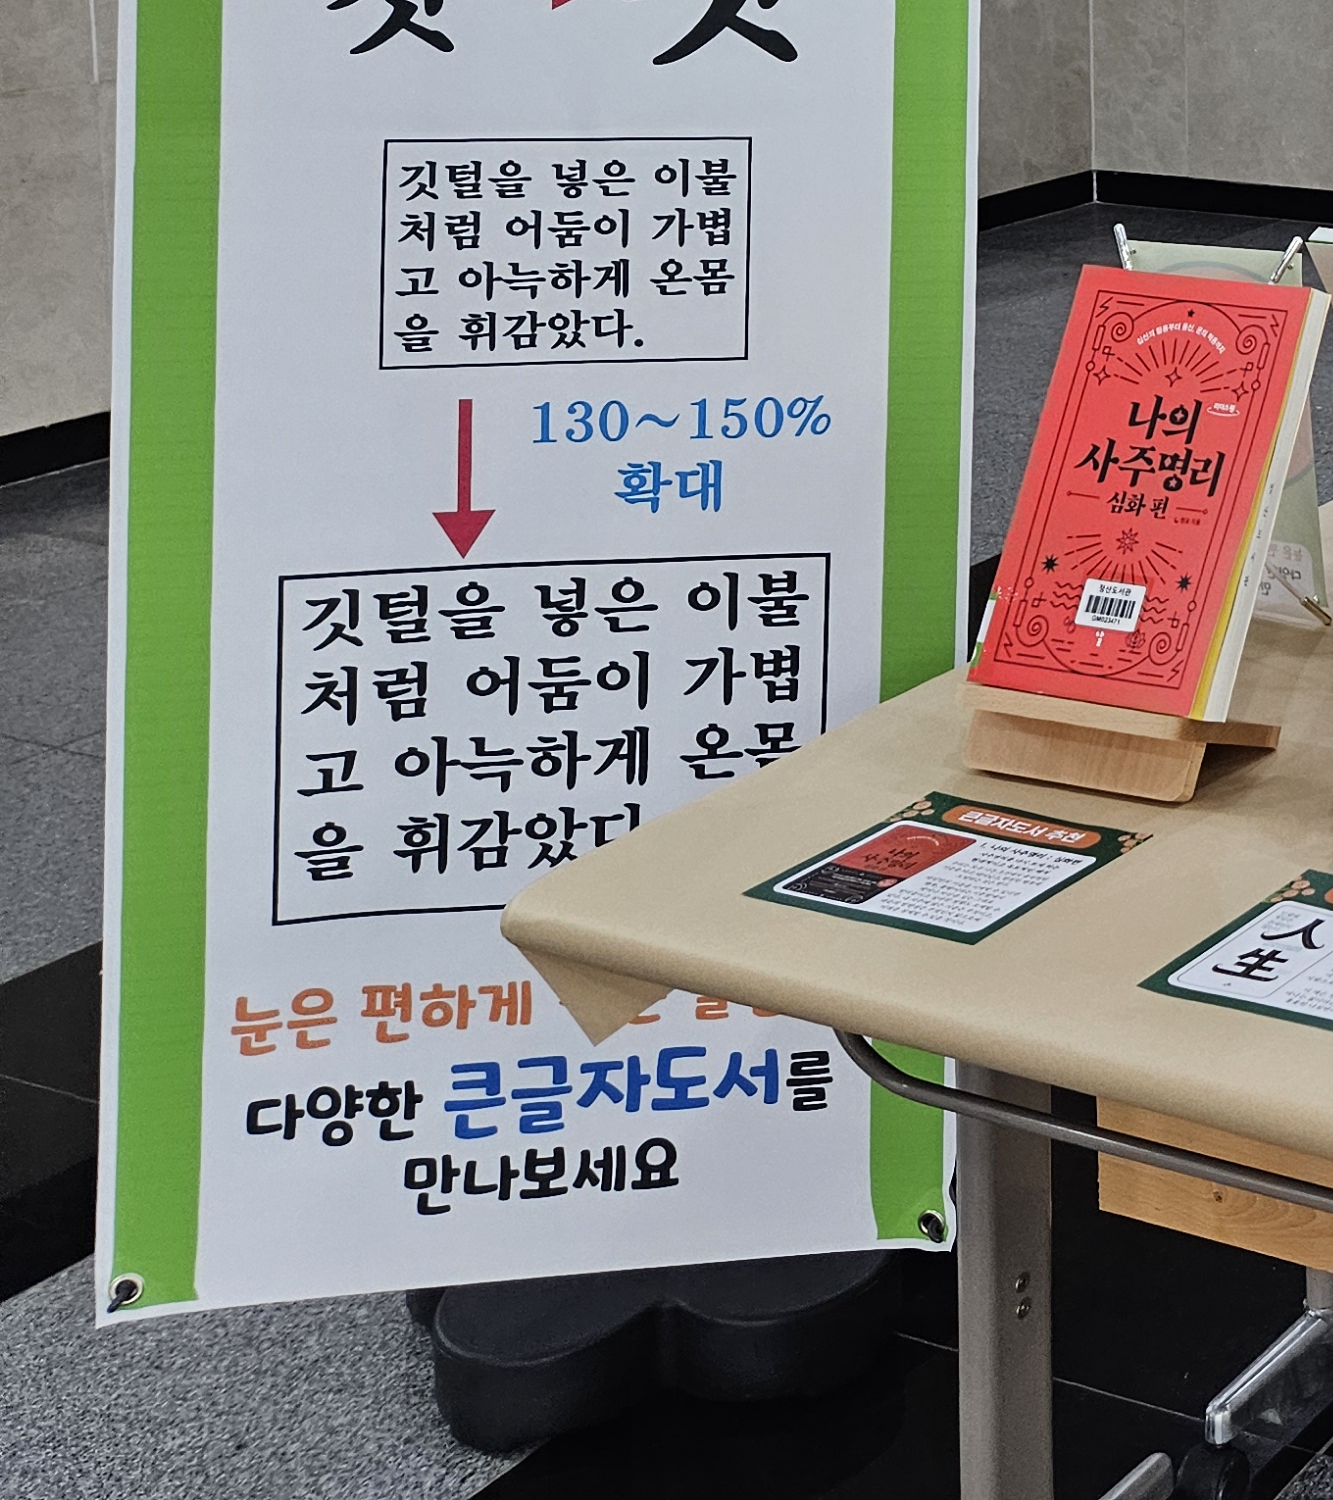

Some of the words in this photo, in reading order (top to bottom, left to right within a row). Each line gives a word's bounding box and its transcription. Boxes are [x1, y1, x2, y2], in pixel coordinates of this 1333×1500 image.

[399, 160, 532, 201] 깃털을
[551, 159, 636, 198] 넣은
[655, 158, 737, 197] 이불
[398, 211, 480, 251] 처럼
[506, 209, 629, 249] 어둠이
[652, 208, 731, 247] 가볍
[395, 268, 439, 296] 고
[459, 259, 629, 301] 아늑하게
[650, 259, 735, 296] 온몸
[394, 314, 439, 352] 을
[459, 309, 643, 351] 휘감았다.
[533, 395, 831, 443] 130~150%
[1128, 394, 1202, 444] 나의
[614, 460, 722, 513] 확대
[1074, 438, 1225, 497] 사주명리
[1106, 491, 1145, 517] 심화
[1150, 496, 1169, 519] 편
[302, 581, 505, 651] 깃털을
[534, 576, 658, 637] 넣은
[688, 570, 809, 631] 이불
[301, 661, 428, 726] 처럼
[467, 651, 649, 716] 어둠이
[683, 645, 800, 705] 가볍
[297, 750, 364, 797] 고
[395, 726, 649, 796] 아늑하게
[294, 822, 364, 881] 을
[231, 988, 337, 1056] 눈은
[361, 981, 532, 1043] 편하게
[246, 1080, 423, 1146] 다양한
[444, 1046, 833, 1139] 큰글자도서를
[404, 1137, 679, 1215] 만나보세요
